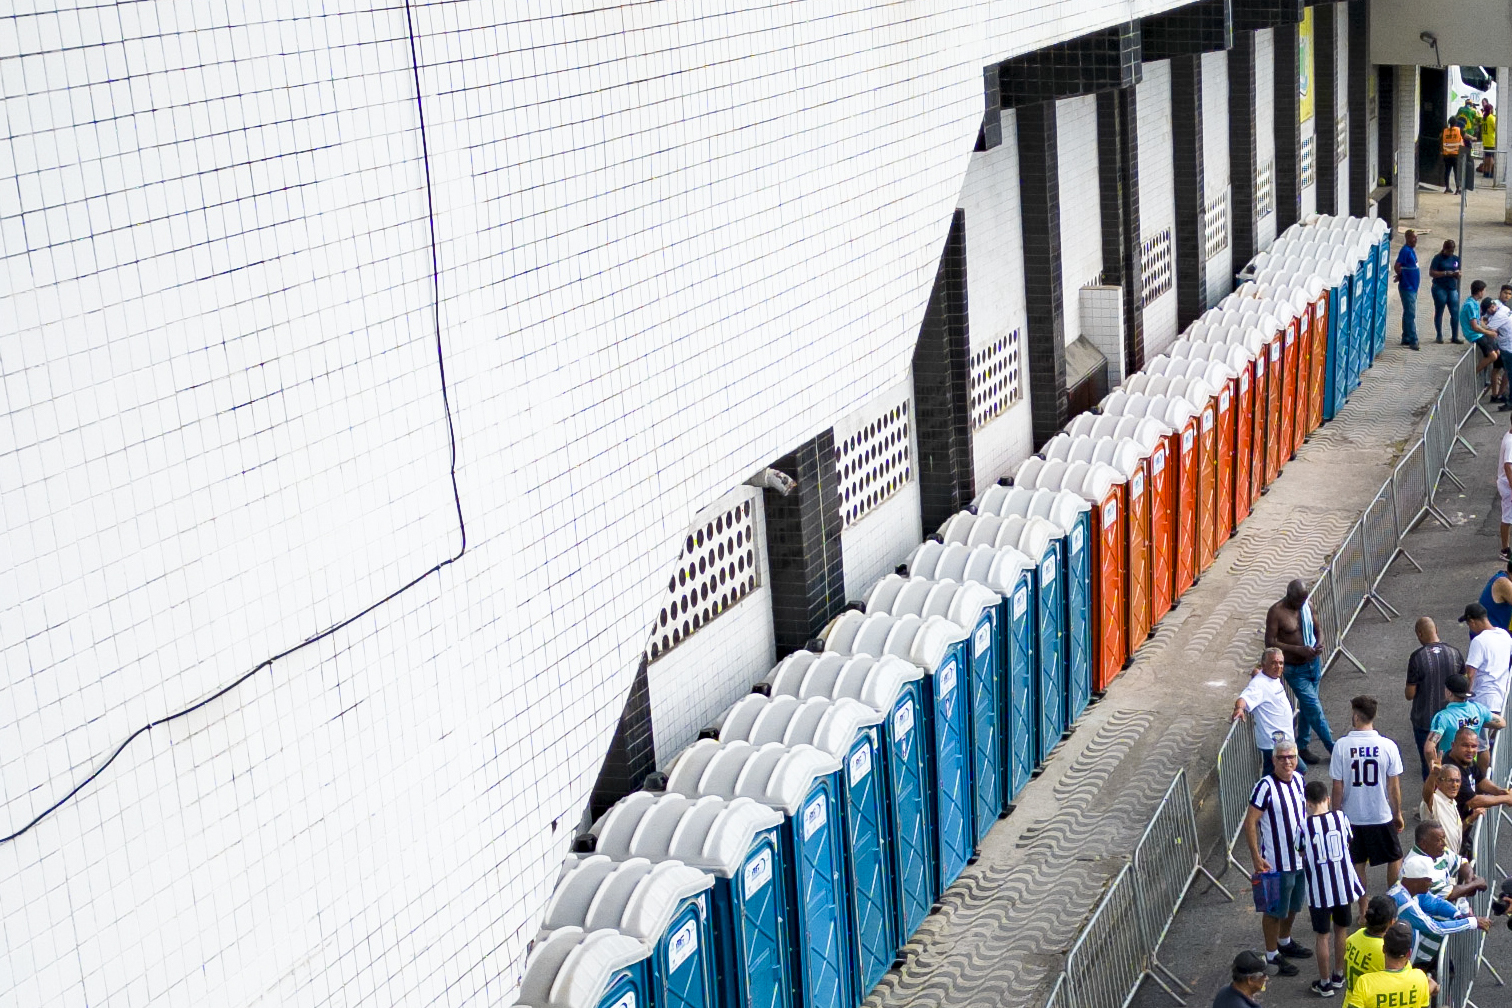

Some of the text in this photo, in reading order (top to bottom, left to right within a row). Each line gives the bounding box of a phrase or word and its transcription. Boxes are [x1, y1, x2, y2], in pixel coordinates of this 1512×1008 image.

[1351, 759, 1379, 787] 10
[1313, 829, 1344, 864] 10
[1346, 942, 1373, 971] PELÉ
[1376, 985, 1417, 1008] PELÉ
